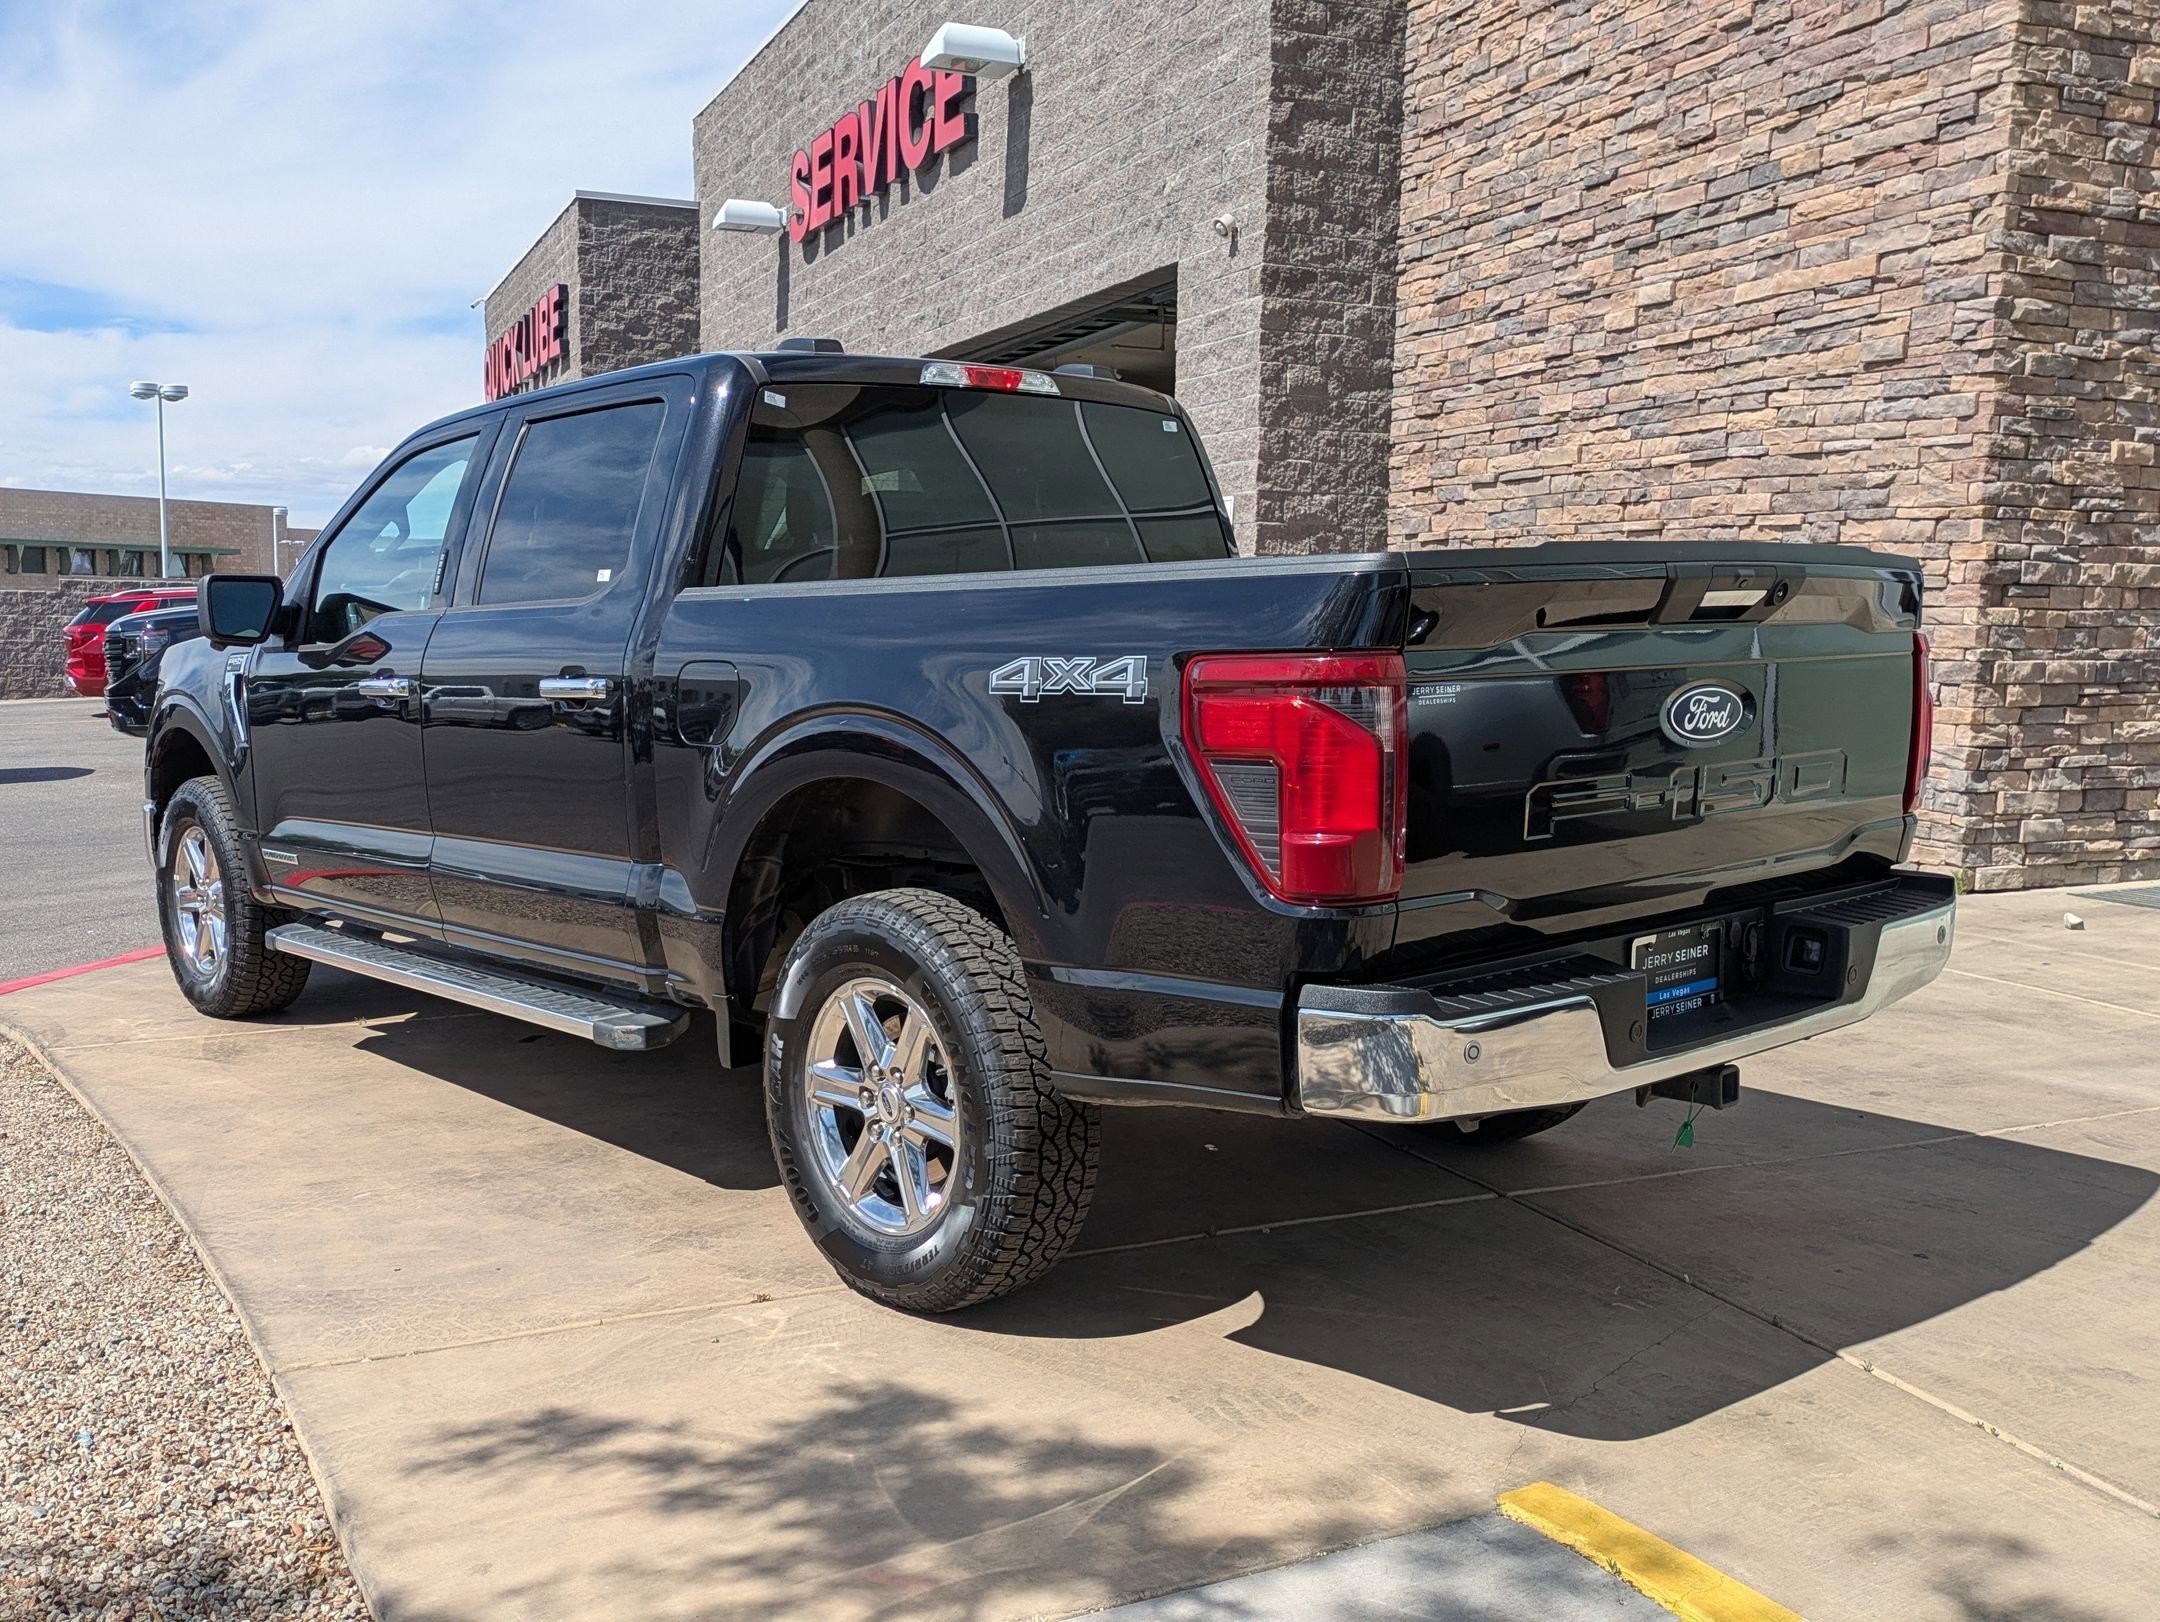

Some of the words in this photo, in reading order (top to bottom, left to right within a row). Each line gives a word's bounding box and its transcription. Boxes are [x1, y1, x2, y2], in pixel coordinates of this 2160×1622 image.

[790, 55, 968, 243] SERVICE
[484, 322, 520, 404] QUICK
[522, 283, 564, 379] LUBE
[1412, 686, 1434, 695] JERRY
[1435, 685, 1461, 694] SEINER
[1418, 697, 1456, 705] DEALERSHIPS
[1684, 695, 1731, 731] Ford
[1230, 776, 1276, 784] FORD
[1524, 749, 1848, 840] F-150
[1677, 928, 1691, 937] Vegas
[1642, 952, 1674, 970] JERRY
[1675, 944, 1709, 963] SEINER
[1655, 968, 1697, 984] DEALERSHIPS
[1659, 991, 1670, 1000] Las
[1671, 987, 1690, 998] Vegas
[1651, 1004, 1675, 1019] JERRY
[1675, 998, 1703, 1013] SEINER
